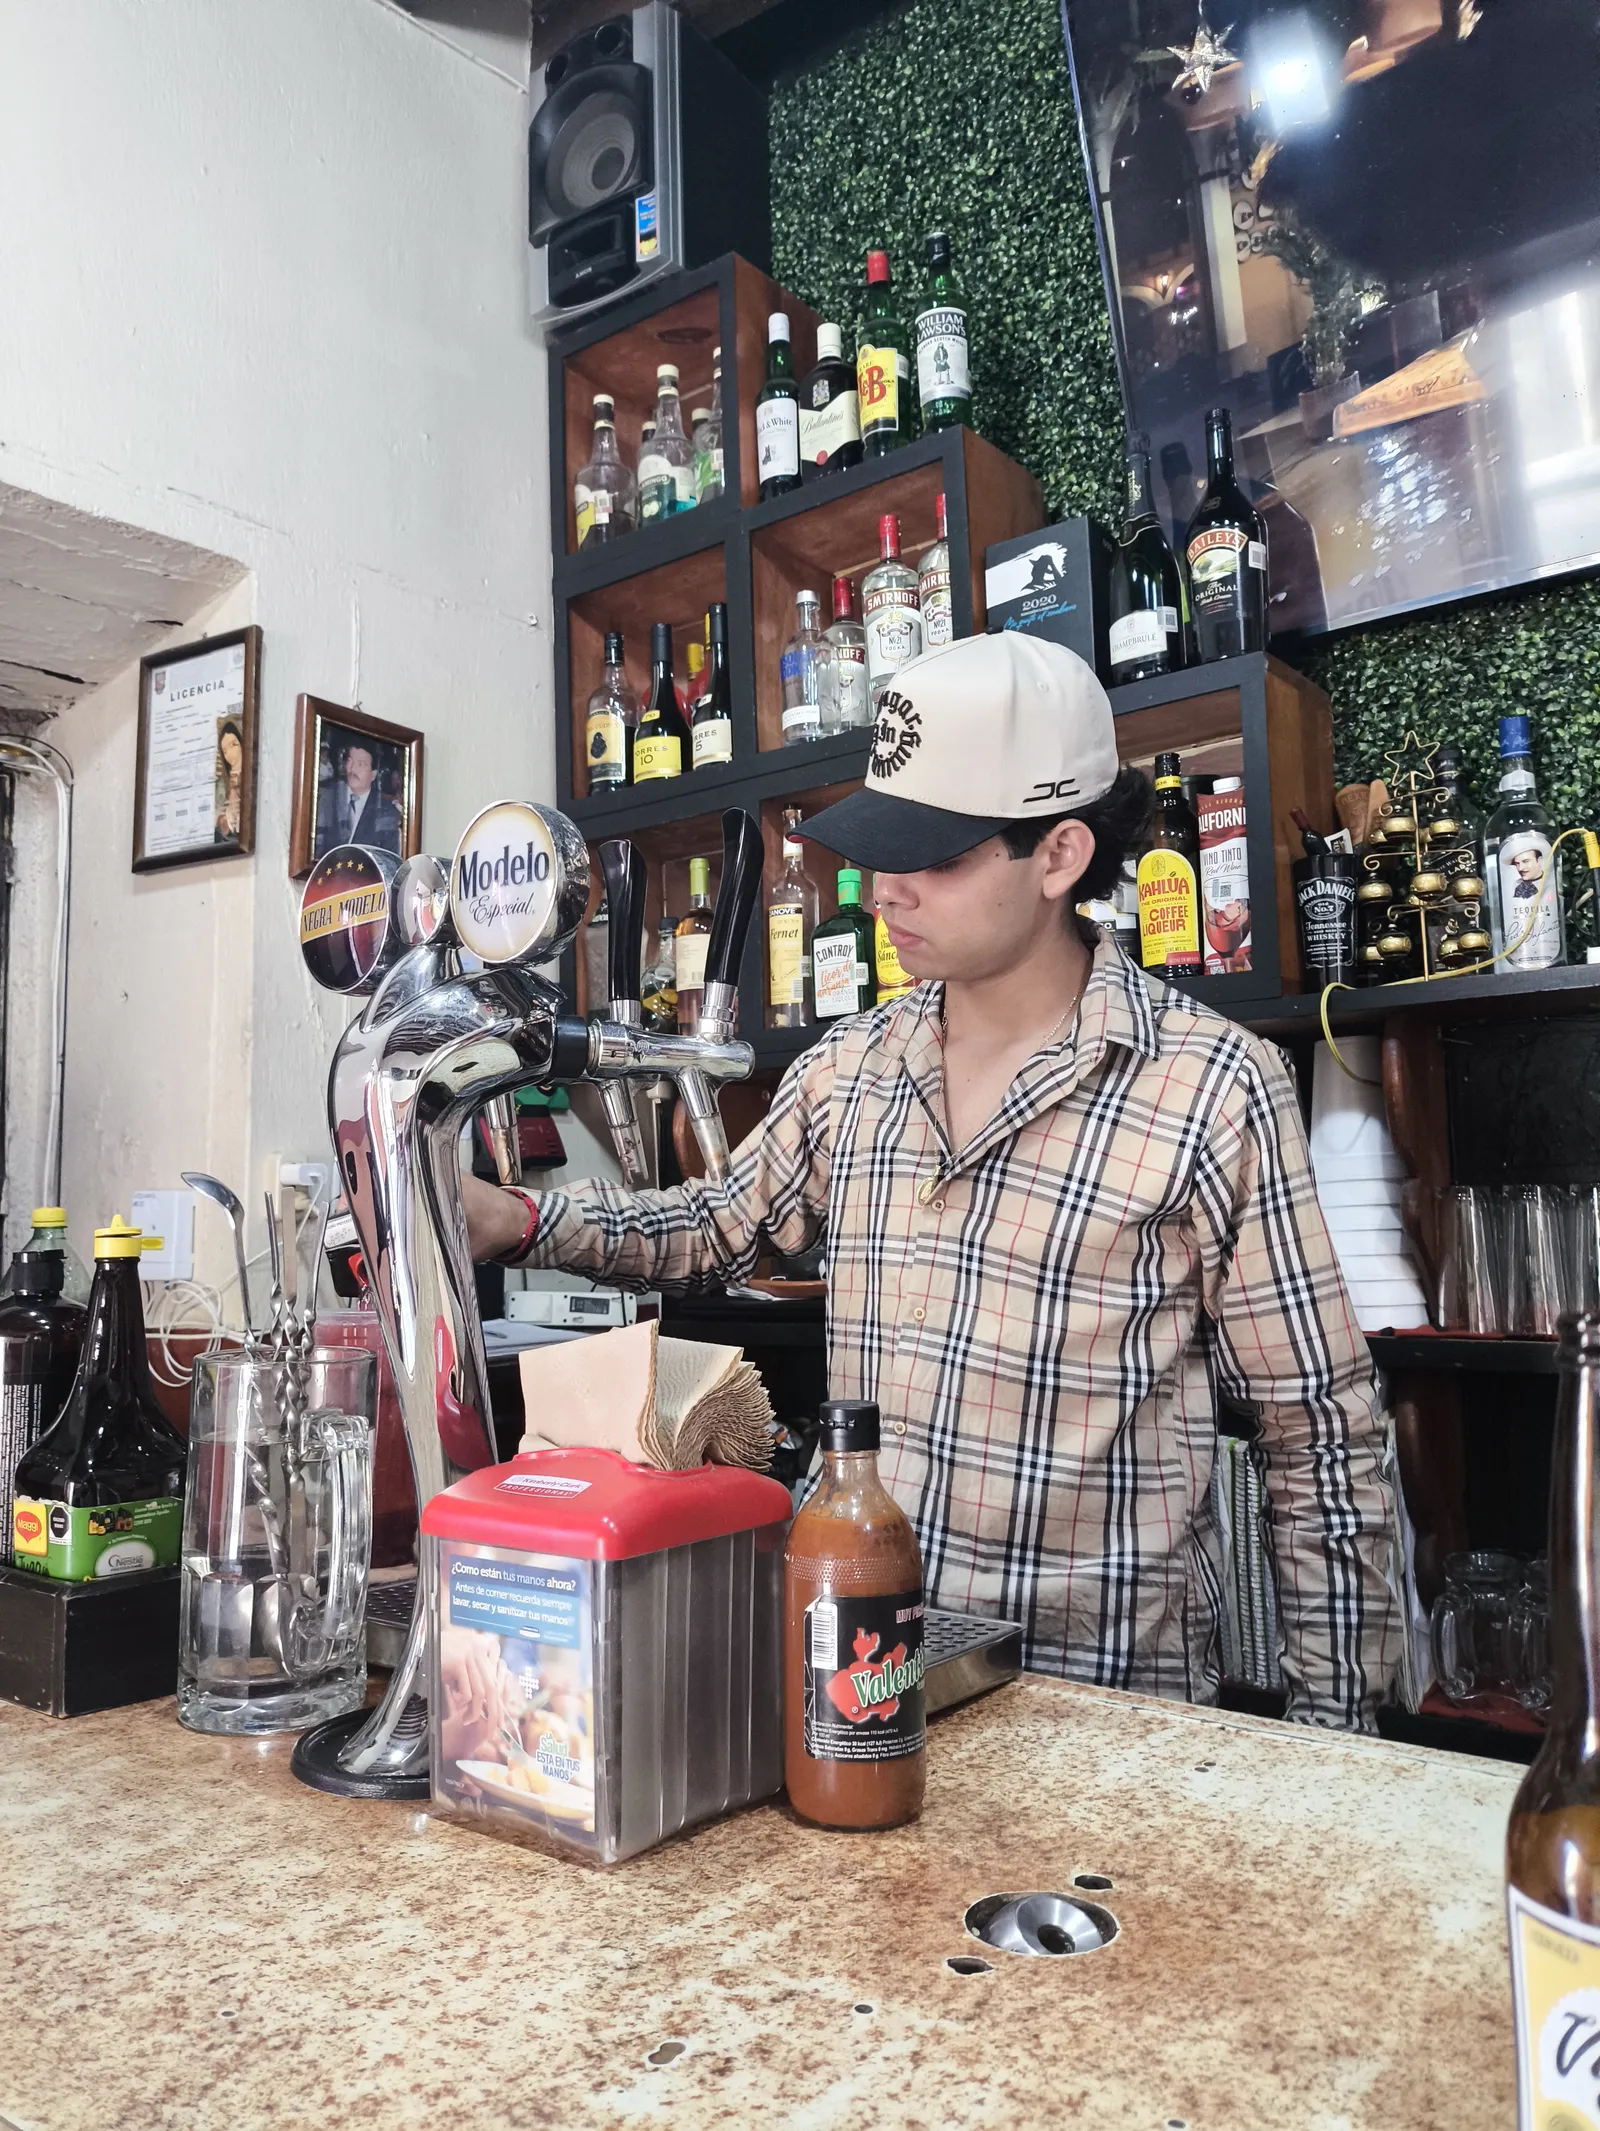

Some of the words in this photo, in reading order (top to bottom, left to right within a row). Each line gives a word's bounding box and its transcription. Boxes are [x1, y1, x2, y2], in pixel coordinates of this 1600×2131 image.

[918, 313, 963, 330] WILLIAM
[917, 323, 966, 344] LAWSON'S
[771, 416, 793, 427] White
[1188, 531, 1241, 558] BAILEYS
[867, 591, 919, 611] SMIRNOFF
[1022, 593, 1057, 611] 2020
[1195, 585, 1239, 602] ORIGINAL
[170, 679, 226, 702] LICENCIA
[695, 740, 703, 752] 5
[640, 753, 654, 766] 10
[1204, 851, 1218, 866] VINO
[1221, 847, 1242, 862] TINTO
[459, 841, 550, 901] Modelo
[1205, 865, 1221, 876] Red
[1223, 863, 1242, 874] Wine
[1152, 896, 1188, 904] ORIGINAL
[1298, 885, 1316, 906] JACK
[1316, 880, 1356, 902] DANIEL'S
[304, 905, 332, 932] NEGRA
[338, 891, 386, 922] MODELO
[469, 892, 535, 927] Especial
[1149, 905, 1189, 921] COFFEE
[1513, 905, 1550, 915] TEQUILA
[770, 928, 798, 940] Fernet
[1143, 919, 1186, 937] LIQUEUR
[1306, 921, 1347, 930] Tennessee
[1307, 933, 1346, 941] WHISKEY
[816, 944, 854, 963] CONTROY
[17, 1519, 39, 1533] Maggi
[115, 1554, 143, 1566] Nestlé
[480, 1568, 502, 1580] están
[502, 1571, 516, 1581] tus
[516, 1574, 545, 1587] manos
[546, 1577, 576, 1592] ahora?
[455, 1582, 476, 1594] Antes
[475, 1585, 485, 1596] de
[485, 1588, 509, 1600] comer
[509, 1592, 541, 1606] recuerda
[541, 1597, 573, 1612] siempre
[452, 1595, 472, 1609] lavar,
[472, 1599, 490, 1610] secar
[491, 1603, 496, 1614] y
[497, 1604, 527, 1618] sanitizar
[528, 1610, 541, 1621] tus
[541, 1614, 569, 1626] manos
[895, 1607, 912, 1624] MUY
[541, 1736, 568, 1758] Salud
[536, 1751, 554, 1766] ESTA
[555, 1756, 565, 1769] EN
[566, 1758, 581, 1772] TUS
[542, 1765, 570, 1781] MANOS
